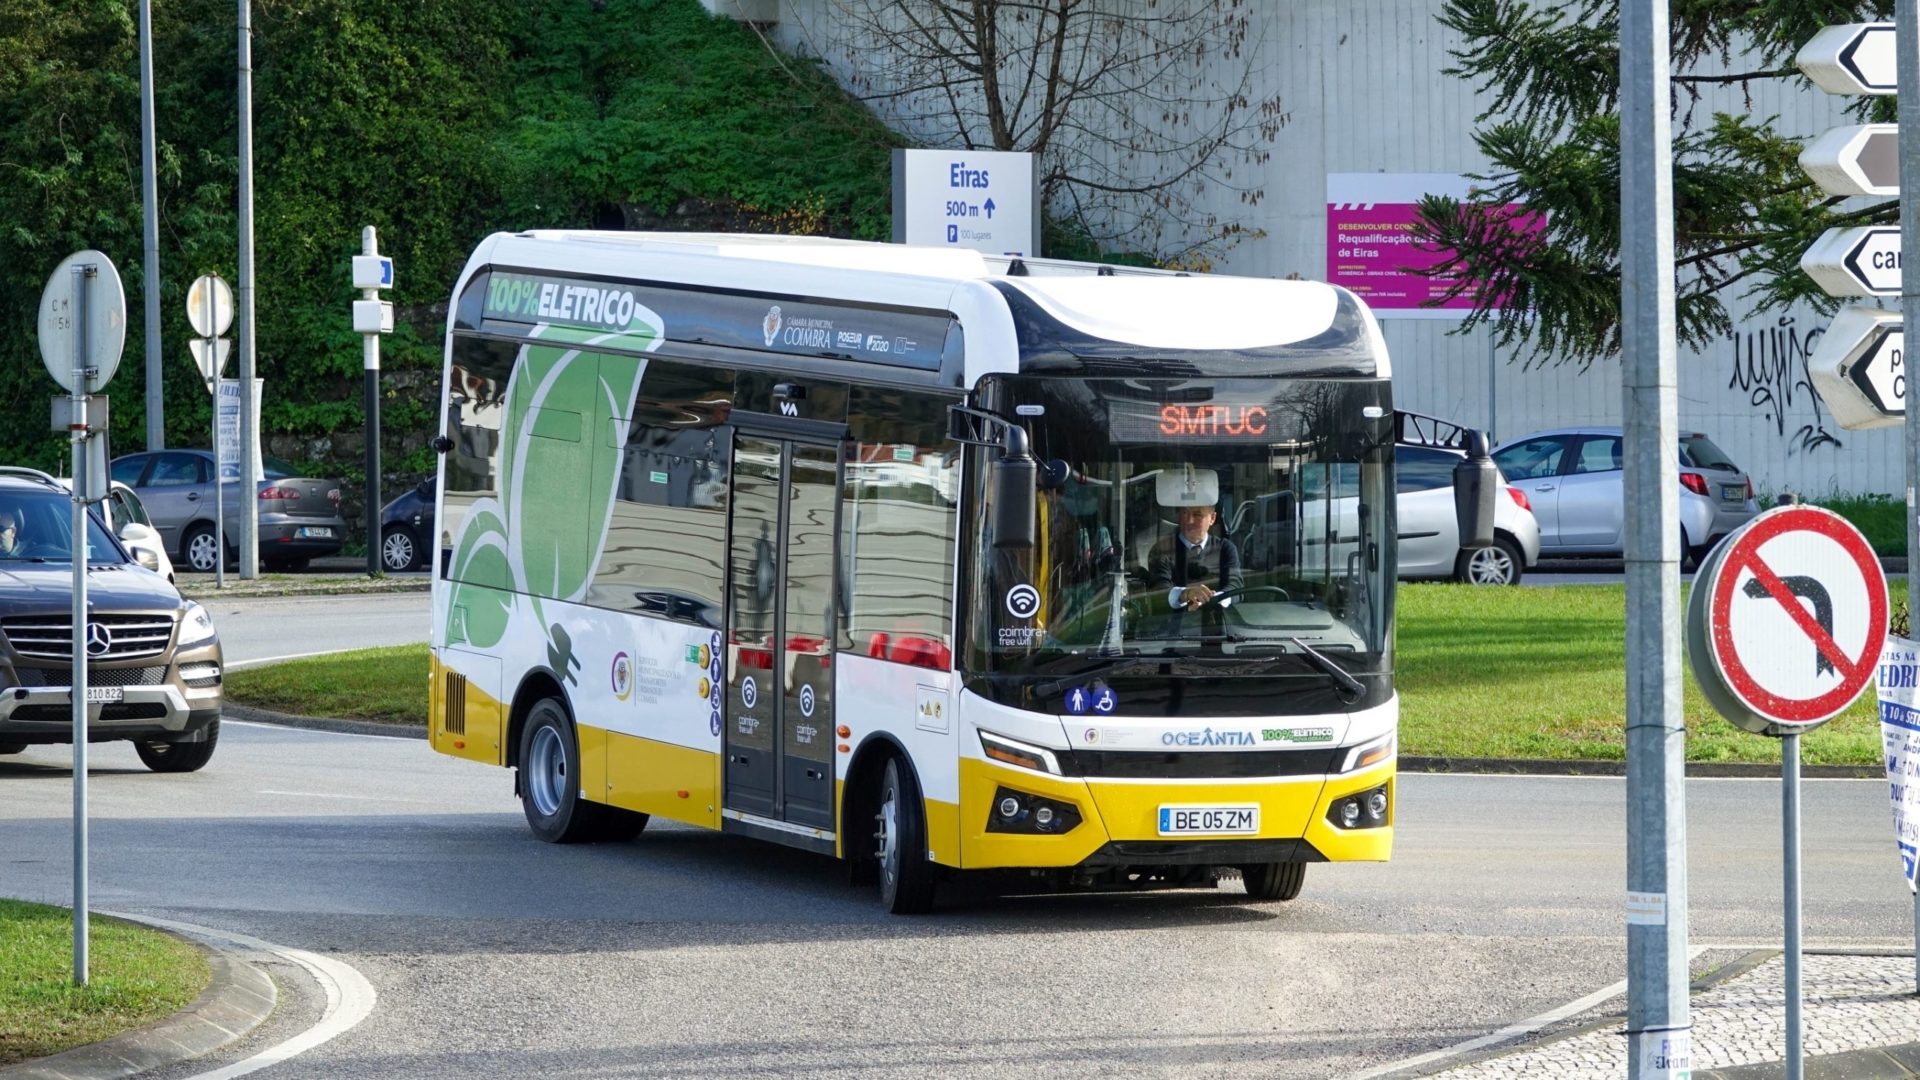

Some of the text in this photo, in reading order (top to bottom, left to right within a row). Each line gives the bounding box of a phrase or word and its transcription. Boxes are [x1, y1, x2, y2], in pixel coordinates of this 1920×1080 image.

[950, 162, 989, 188] Eiras
[946, 201, 979, 217] 500 m
[1338, 223, 1393, 231] DESENVOLVER
[960, 230, 971, 240] 100
[1338, 233, 1412, 246] Requalificação
[1338, 248, 1379, 258] de Eiras
[488, 278, 539, 316] 100%
[784, 327, 831, 349] COIMBRA
[871, 340, 890, 353] 2020
[1160, 405, 1268, 435] SMTUC
[999, 637, 1032, 646] free wifi
[1904, 652, 1916, 661] NA
[1162, 727, 1257, 746] OCEÂNTIA
[1262, 729, 1294, 741] 100%
[1175, 811, 1252, 829] BE 05 ZM
